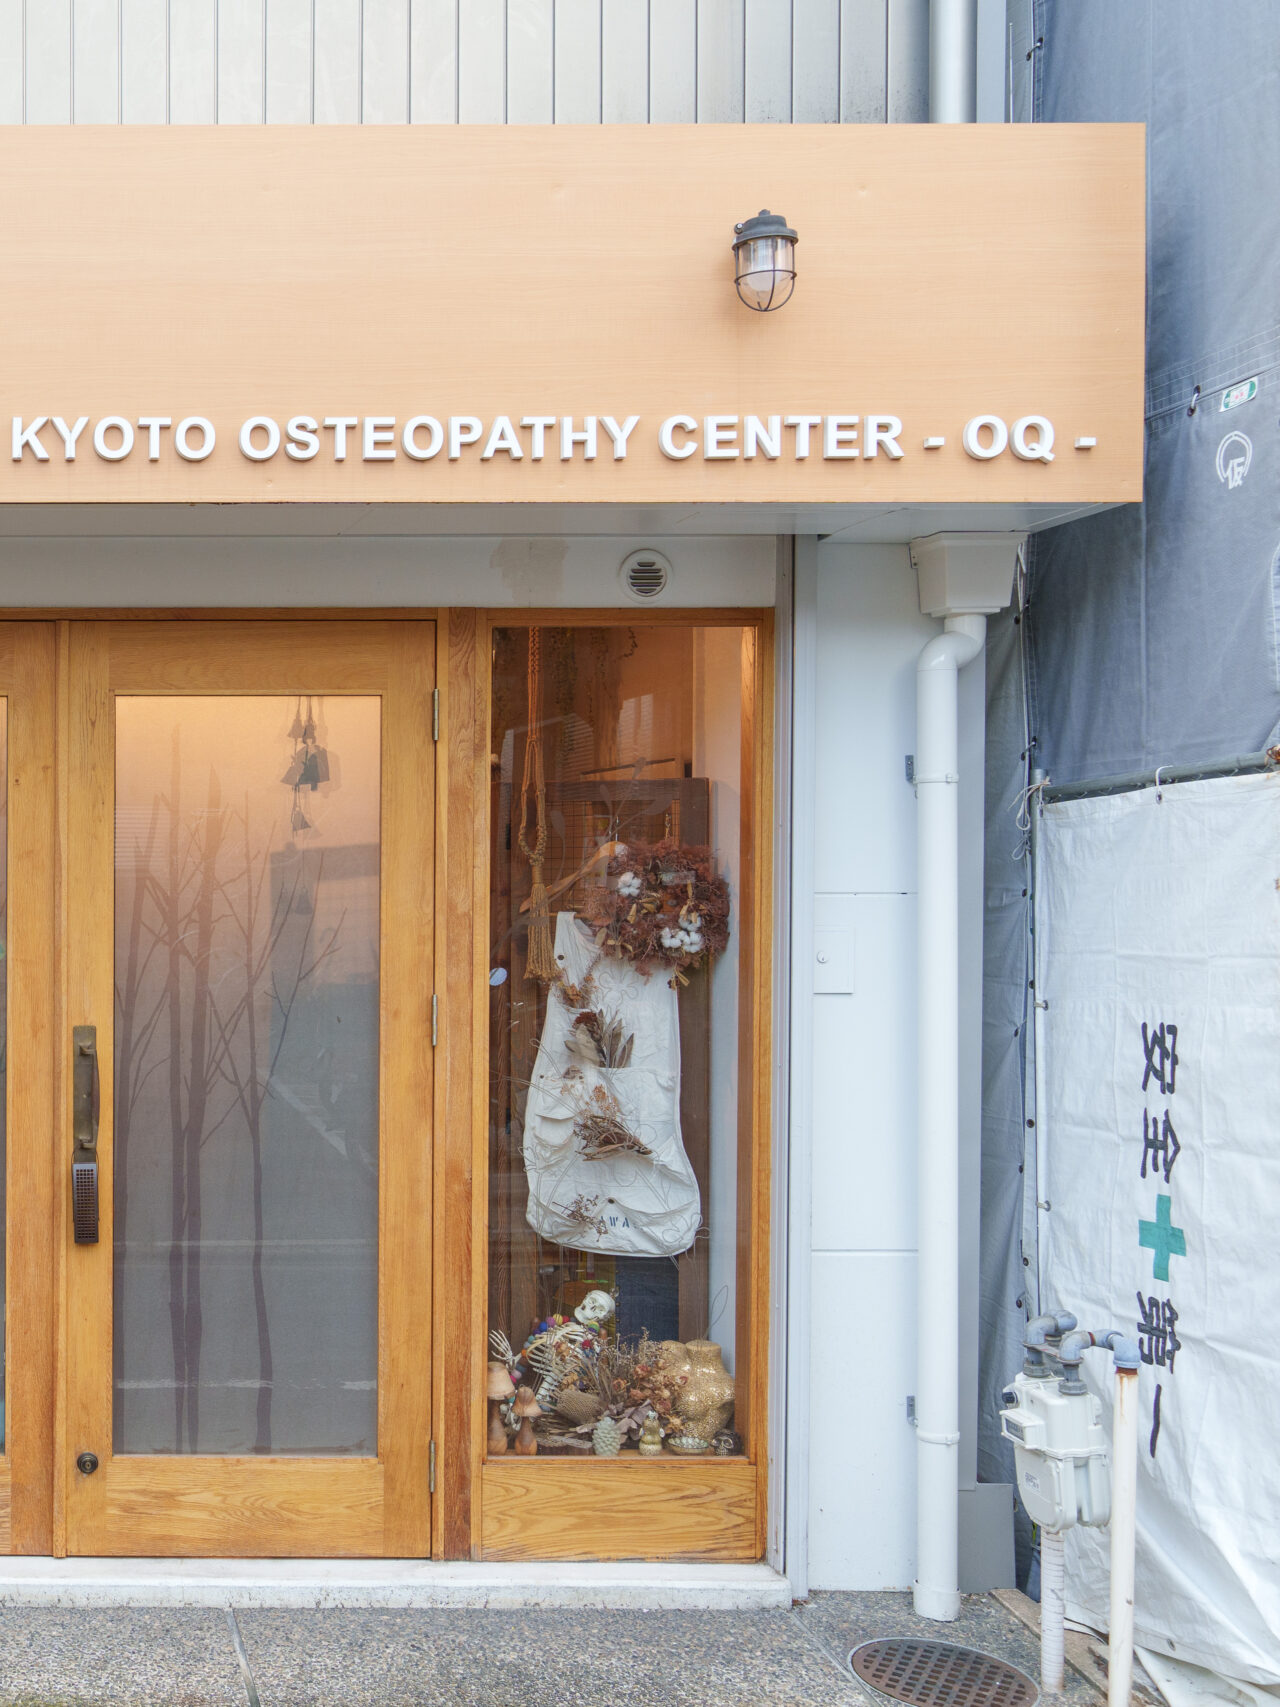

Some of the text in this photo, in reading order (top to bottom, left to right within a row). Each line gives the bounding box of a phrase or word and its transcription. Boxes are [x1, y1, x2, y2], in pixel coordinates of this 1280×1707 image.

[11, 416, 216, 461] KYOTO
[238, 415, 639, 461] OSTEOPATHY
[658, 414, 904, 460] CENTER
[962, 414, 1055, 464] OQ
